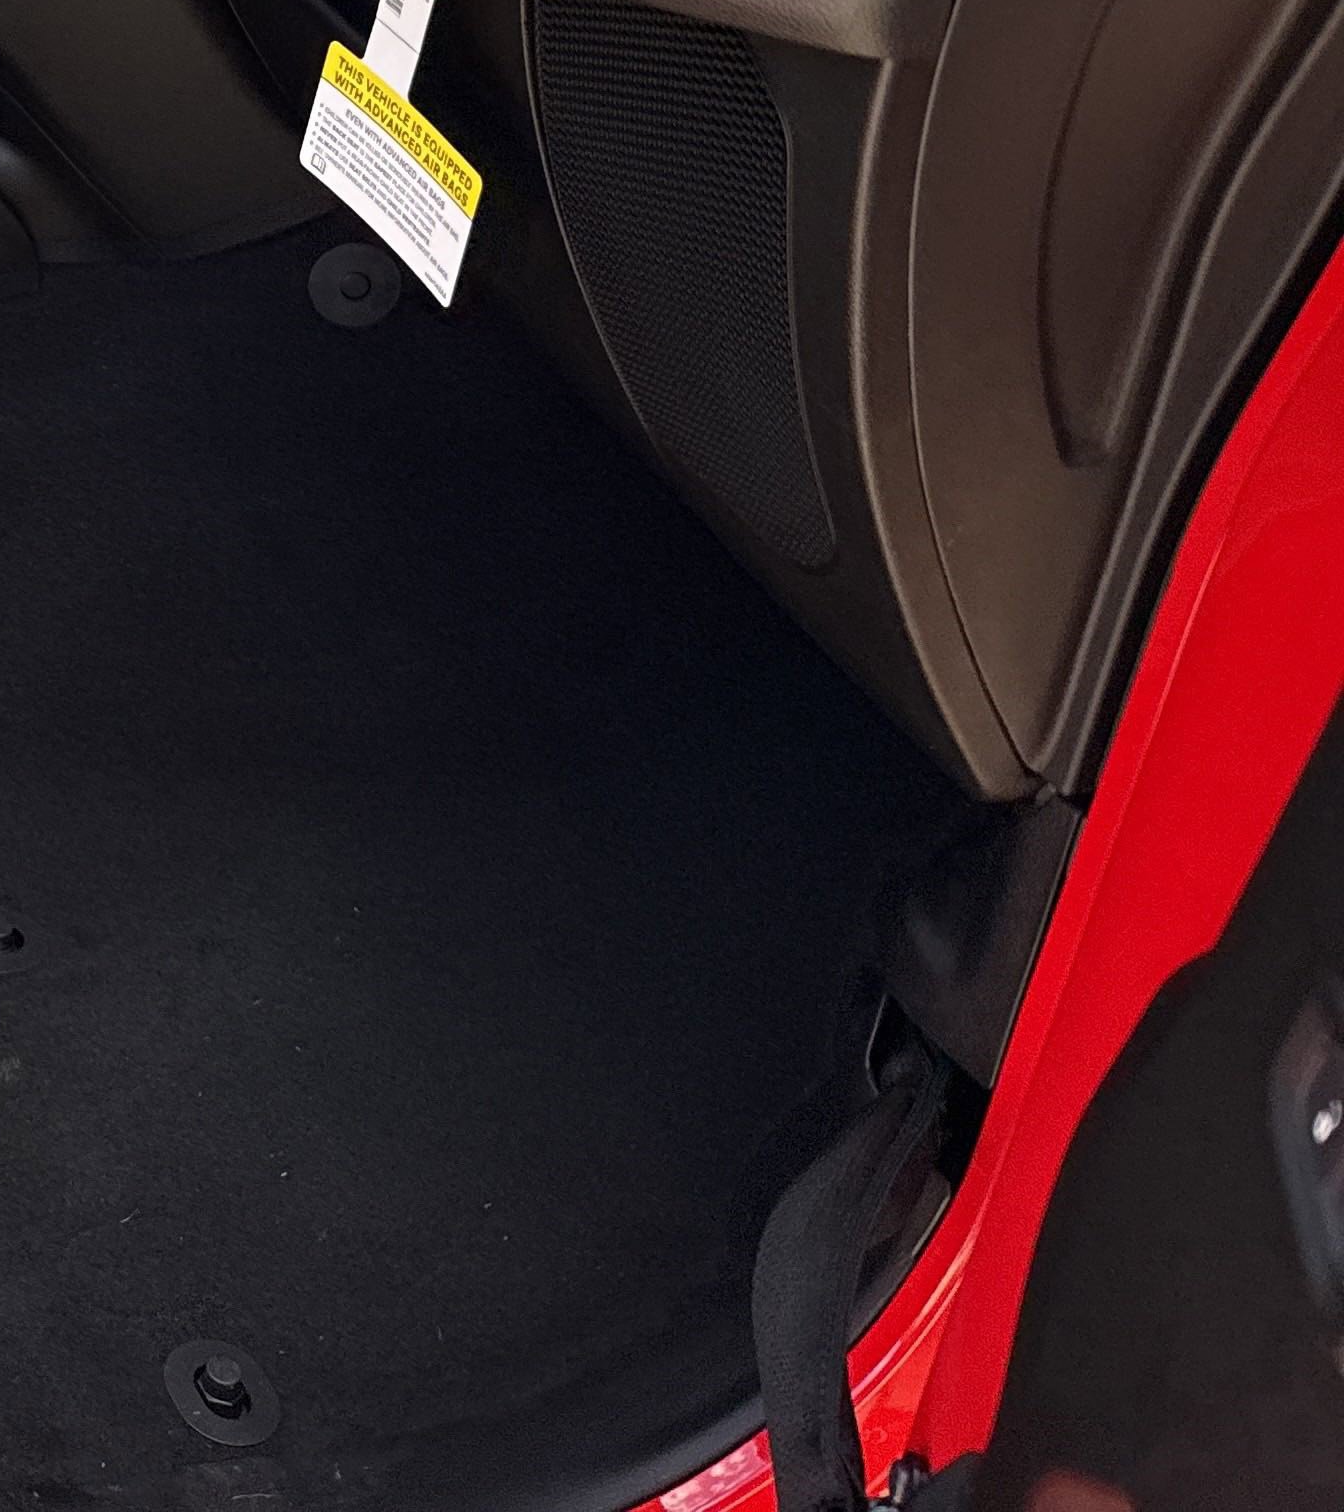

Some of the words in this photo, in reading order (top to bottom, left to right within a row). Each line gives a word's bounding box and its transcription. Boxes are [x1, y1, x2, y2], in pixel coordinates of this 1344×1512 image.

[333, 70, 363, 104] WITH
[363, 95, 422, 158] ADVANCED
[422, 149, 441, 177] AIR
[441, 170, 469, 208] BAGS
[337, 54, 364, 86] THIS
[365, 78, 410, 128] VEHICLE
[411, 121, 422, 139] IS
[422, 132, 474, 193] EQUIPPED
[345, 107, 364, 130] EVEN
[364, 124, 382, 146] WITH
[382, 140, 417, 181] ADVANCED
[416, 175, 428, 192] AIR
[428, 187, 446, 211] BAGS
